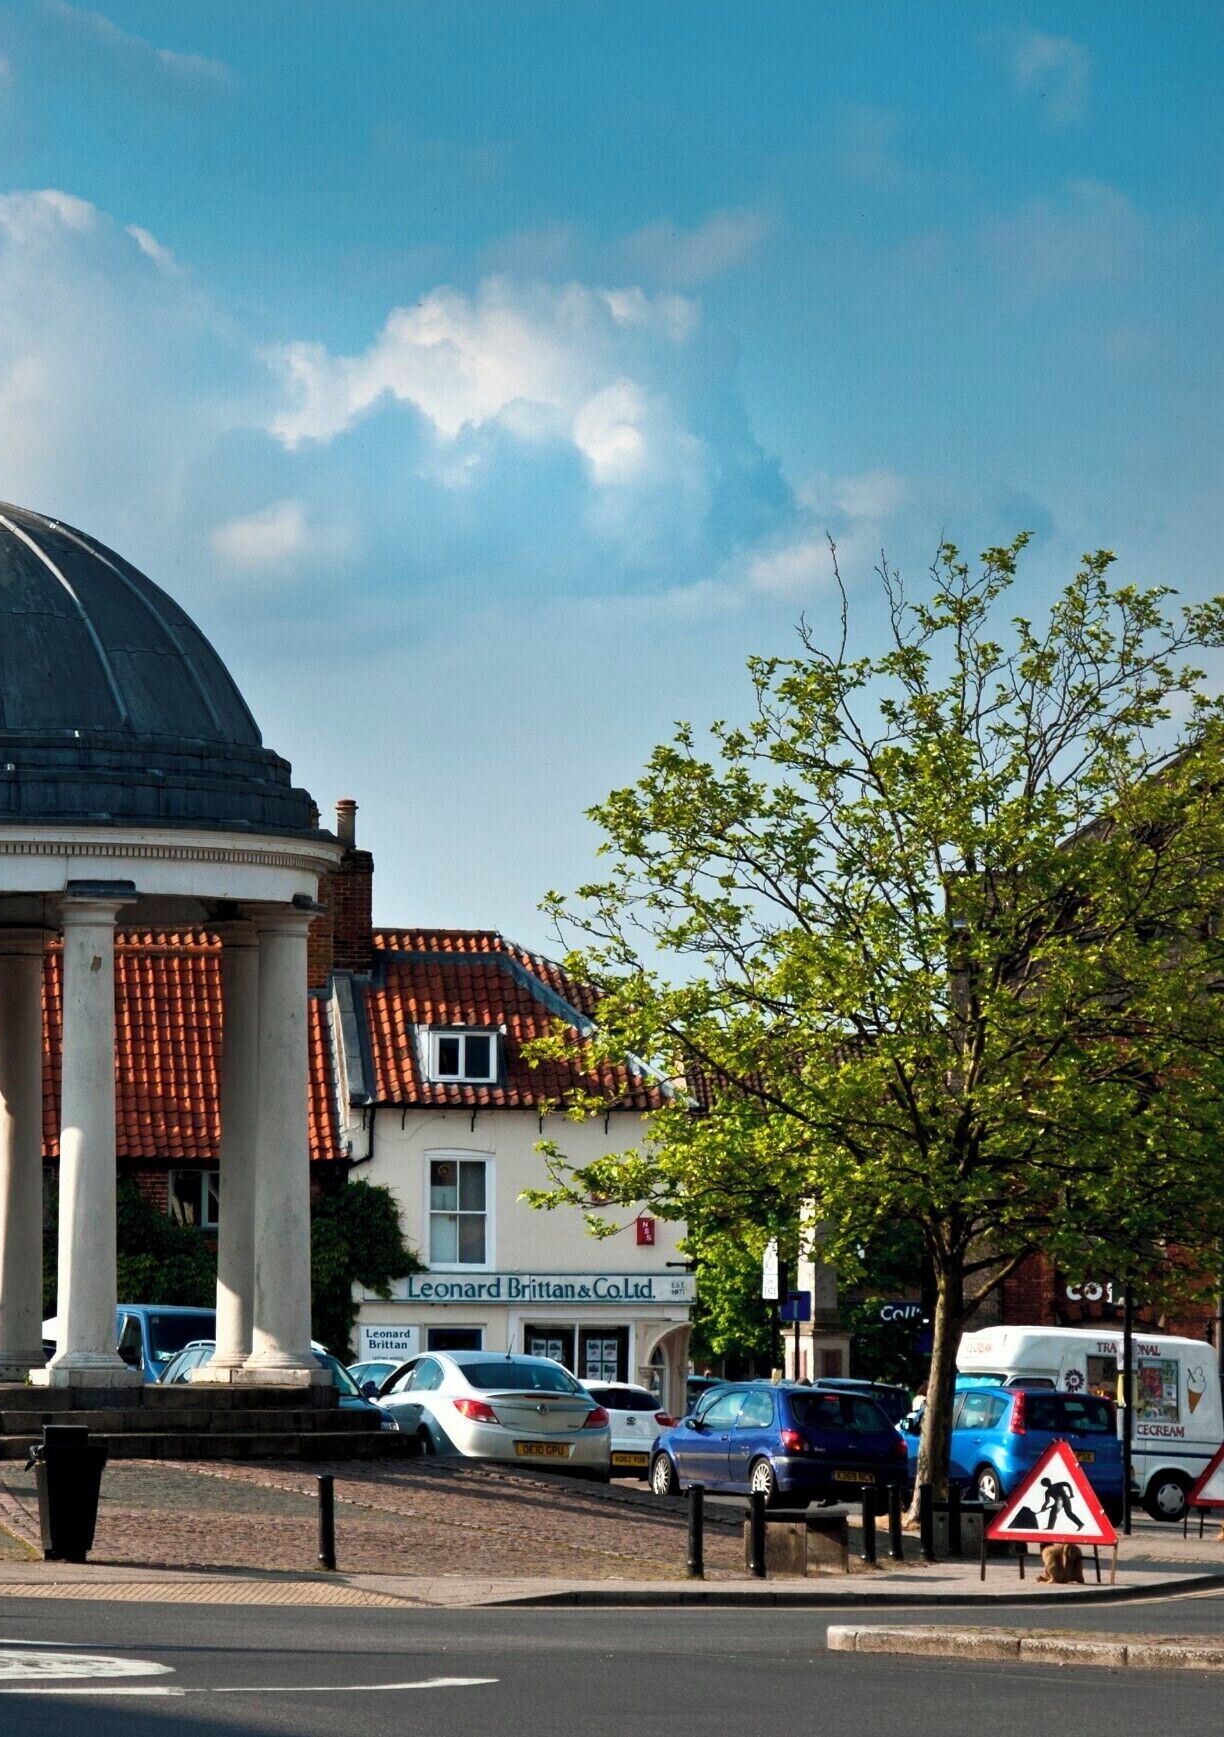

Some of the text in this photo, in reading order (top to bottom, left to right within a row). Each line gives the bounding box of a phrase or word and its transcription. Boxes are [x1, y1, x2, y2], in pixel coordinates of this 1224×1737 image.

[407, 1277, 501, 1299] Leonard
[508, 1277, 575, 1299] Brittan
[366, 1329, 410, 1338] Leonard
[369, 1340, 408, 1349] Brittan
[1137, 1424, 1185, 1438] CECREAM
